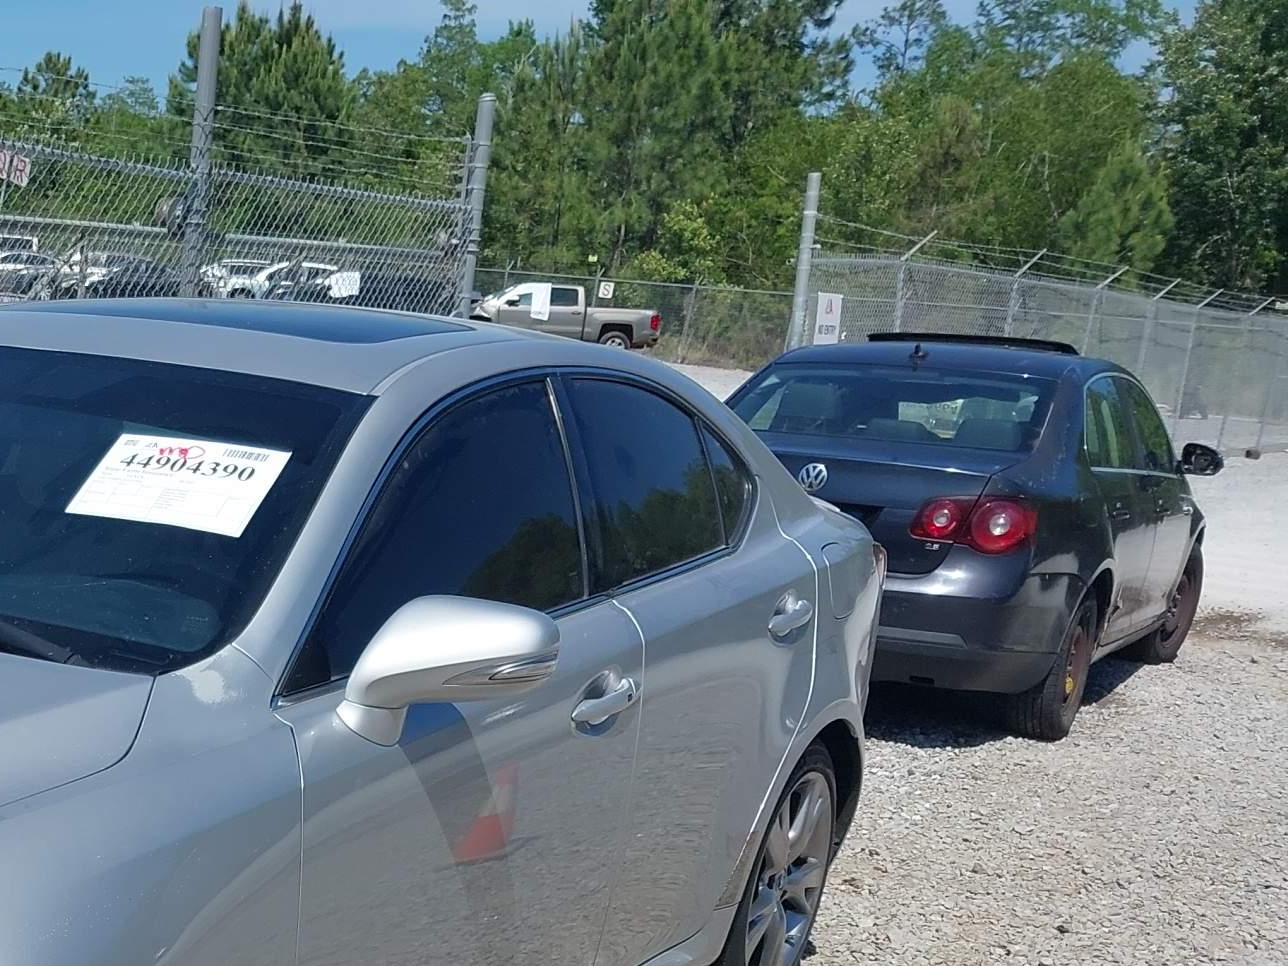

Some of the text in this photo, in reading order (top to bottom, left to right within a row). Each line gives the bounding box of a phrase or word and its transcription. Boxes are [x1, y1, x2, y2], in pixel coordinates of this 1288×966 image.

[15, 159, 26, 183] R
[602, 284, 610, 296] S
[119, 453, 256, 482] 44904390
